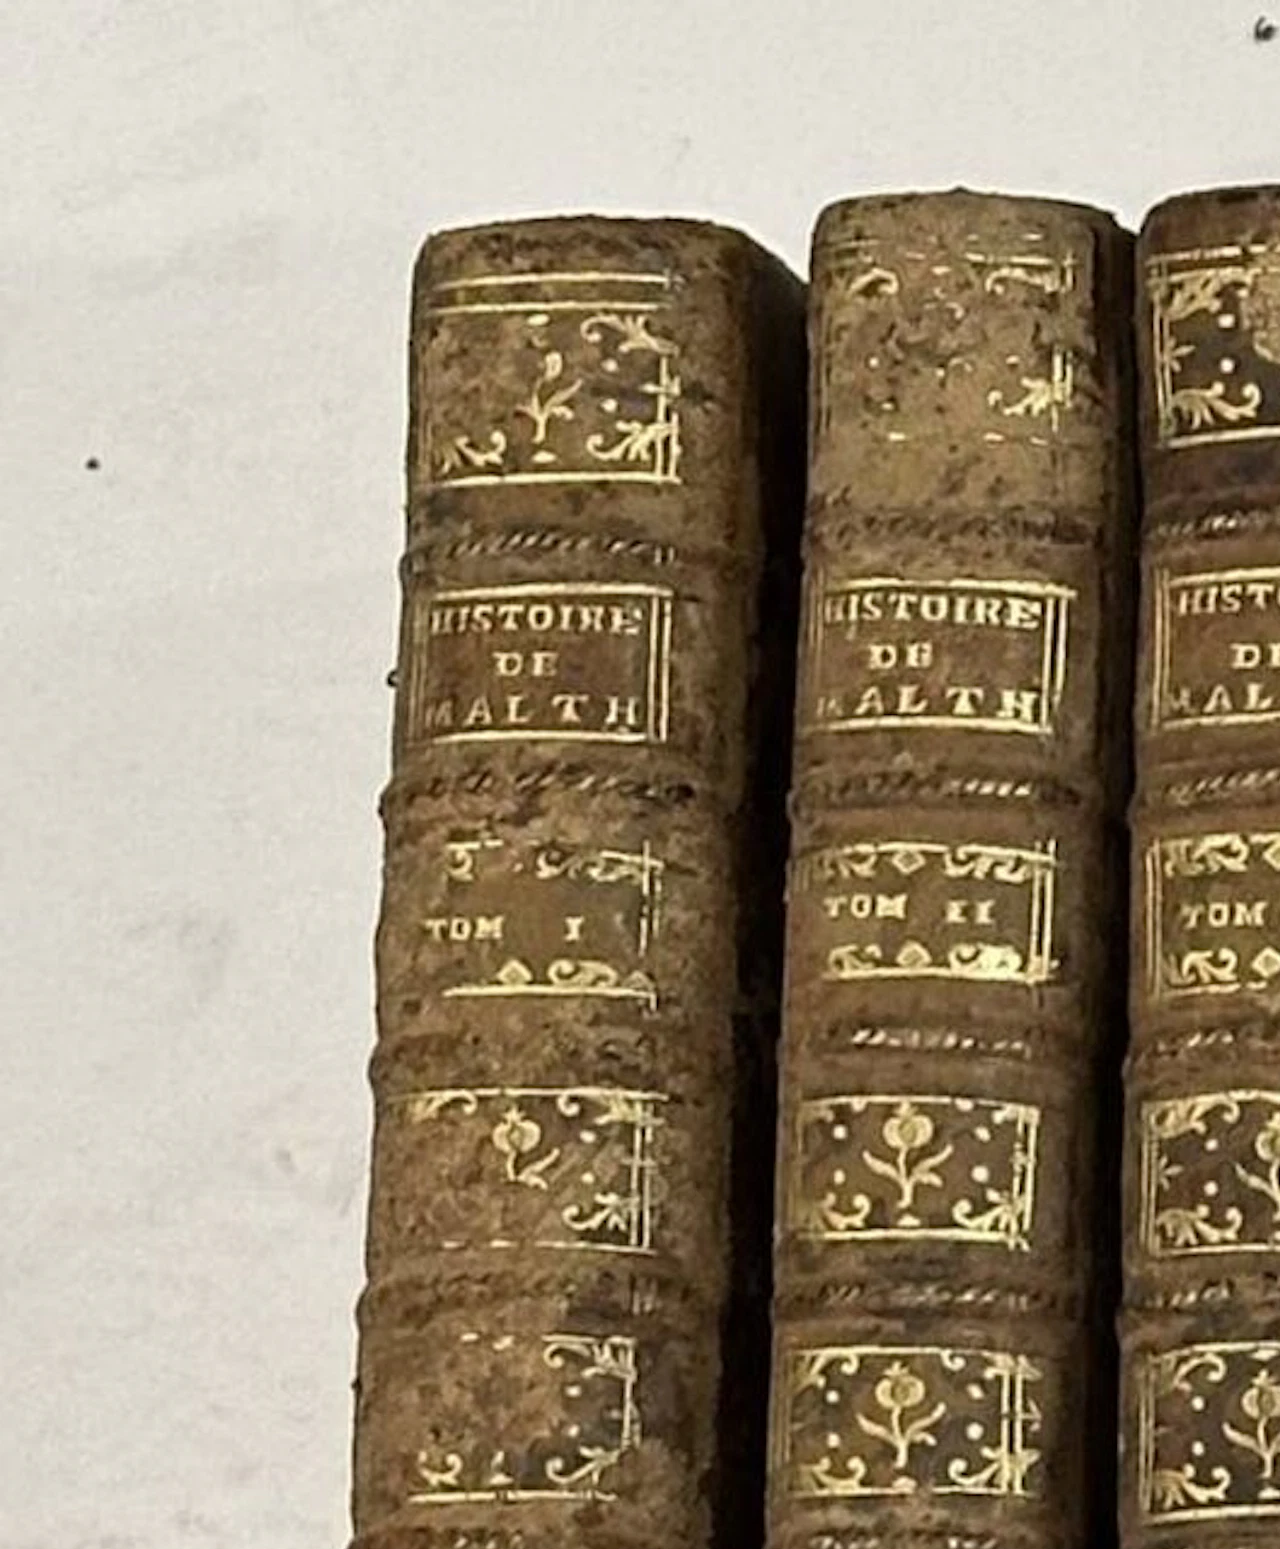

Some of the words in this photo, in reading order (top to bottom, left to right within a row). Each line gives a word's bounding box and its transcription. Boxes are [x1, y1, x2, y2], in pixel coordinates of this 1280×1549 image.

[493, 652, 559, 676] DE
[868, 642, 933, 668] DE
[823, 894, 906, 920] TOM
[946, 898, 996, 924] II
[1179, 901, 1268, 928] TOM
[423, 916, 503, 940] TOM
[565, 916, 584, 940] I
